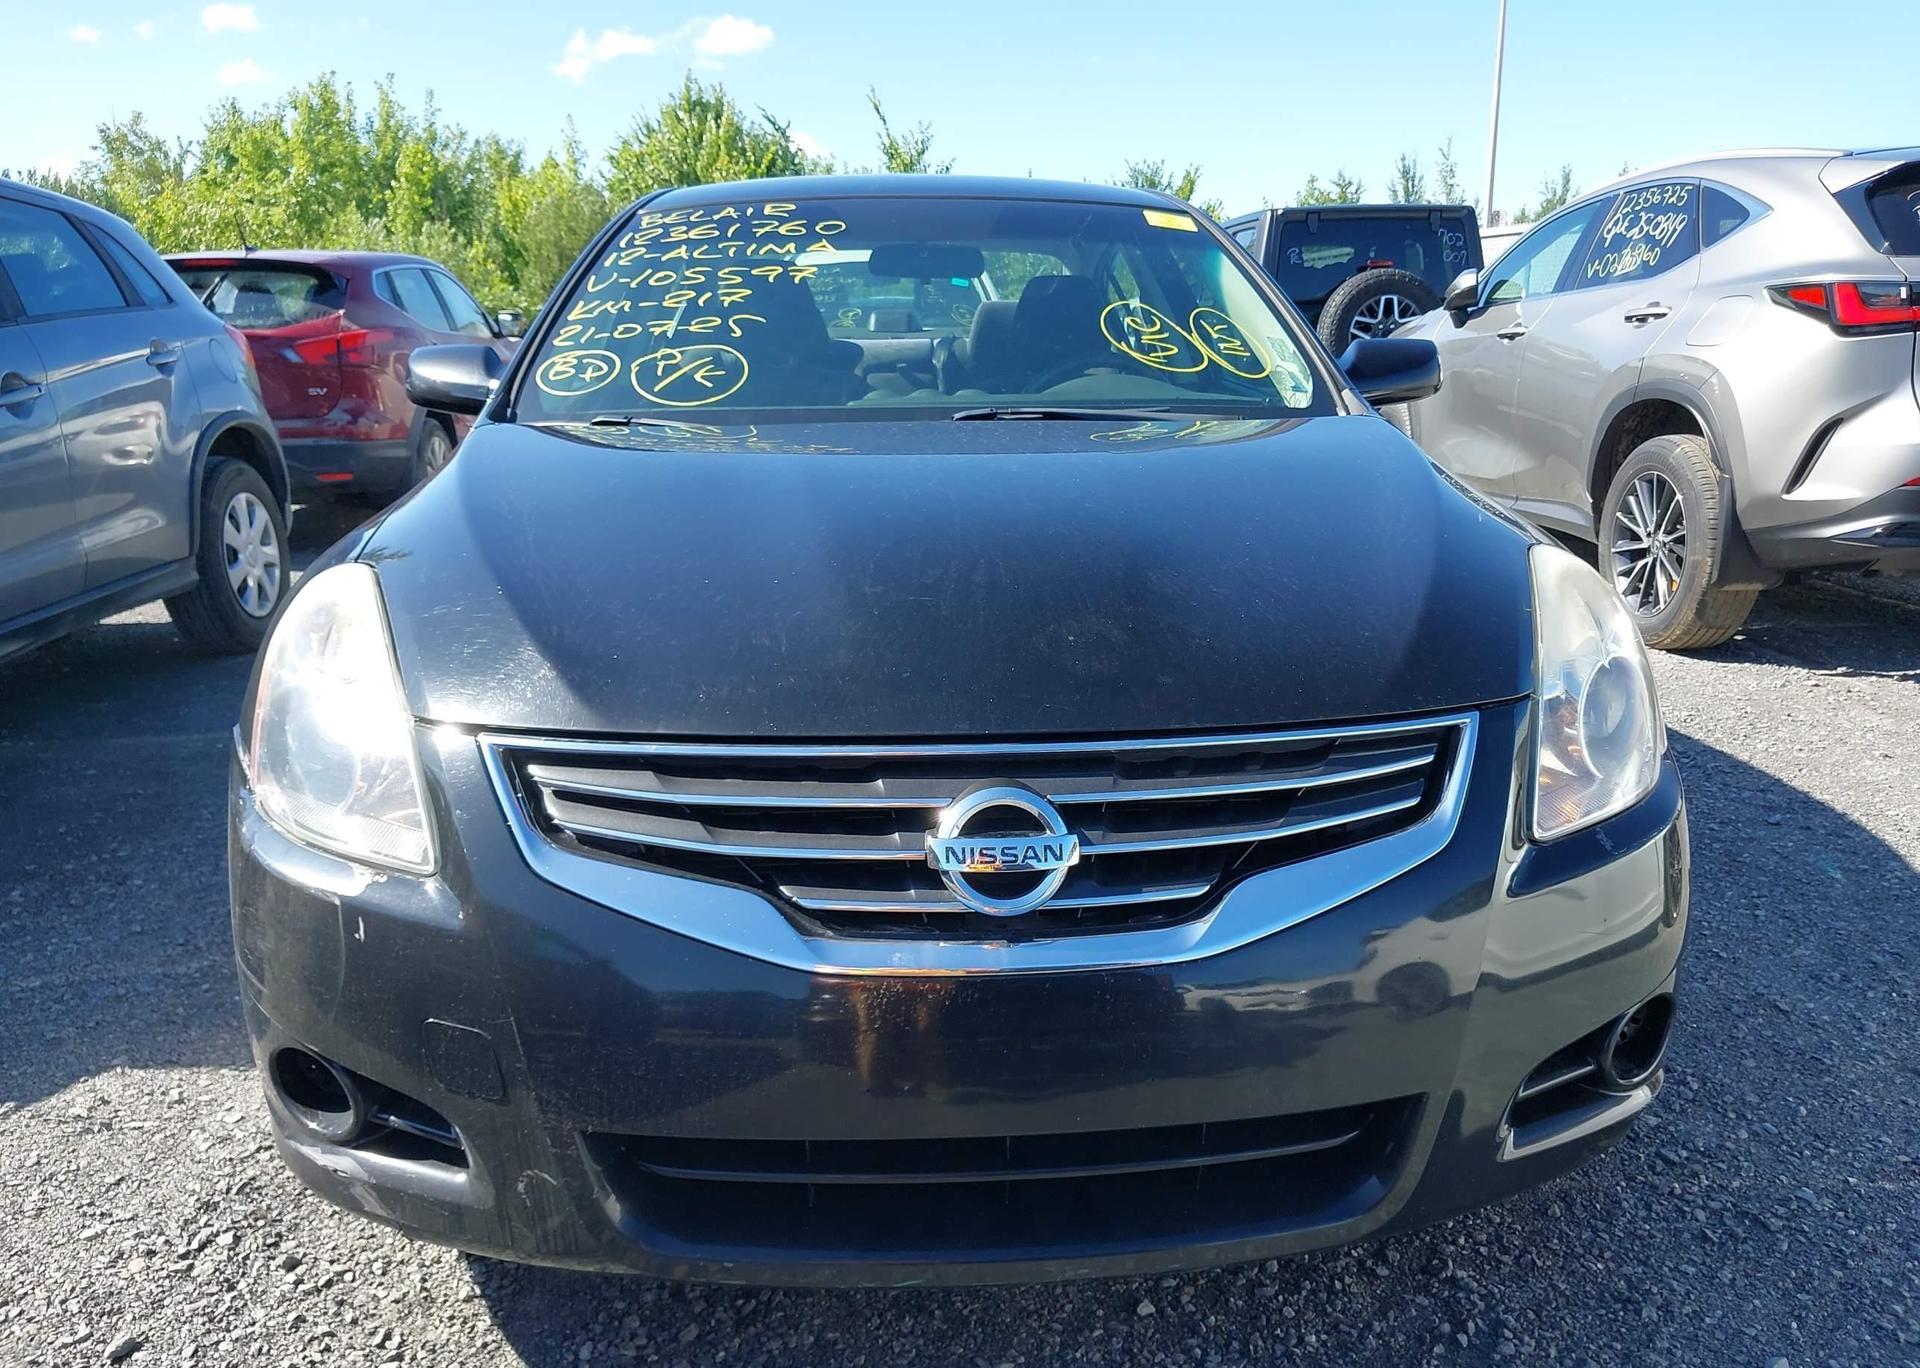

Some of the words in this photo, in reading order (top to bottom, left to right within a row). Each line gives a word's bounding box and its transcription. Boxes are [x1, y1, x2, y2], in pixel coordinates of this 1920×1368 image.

[1618, 186, 1693, 214] 12356725
[638, 203, 797, 229] BELAIR
[619, 219, 847, 248] 12361760
[604, 238, 839, 267] 12-ALTIMA
[944, 842, 1064, 865] NISSAN
